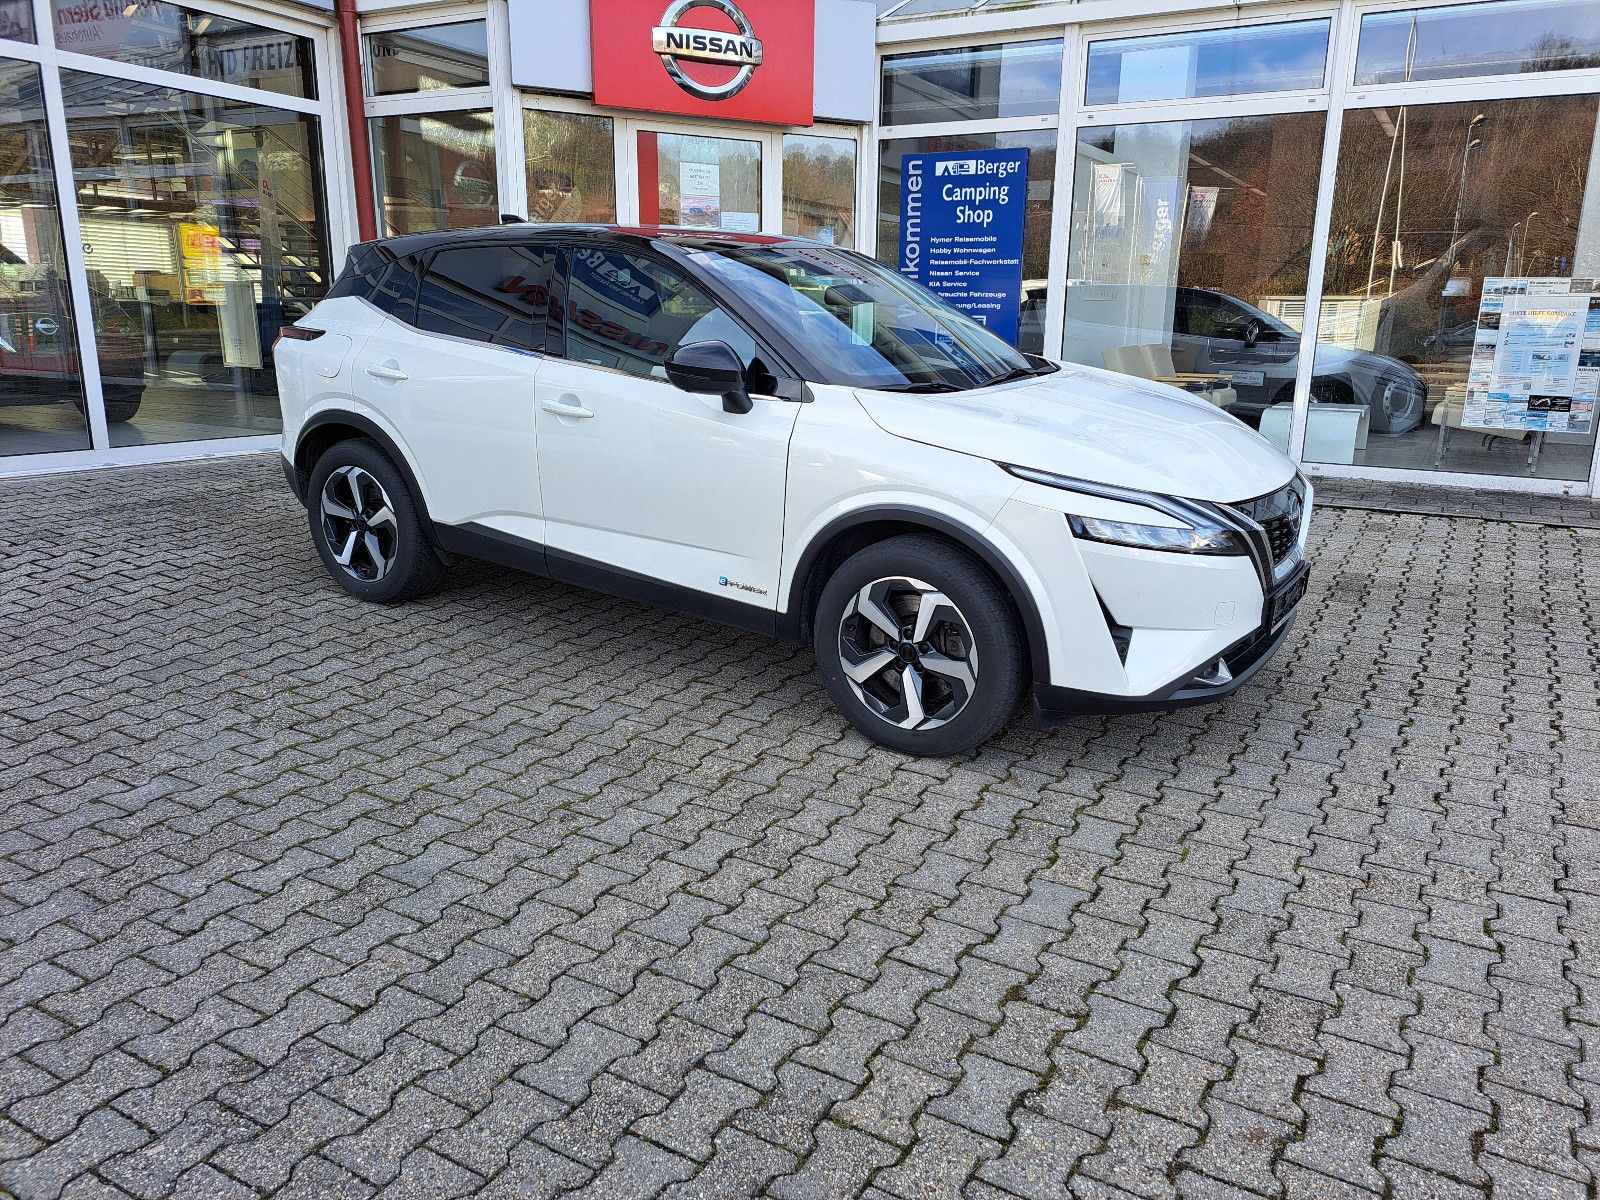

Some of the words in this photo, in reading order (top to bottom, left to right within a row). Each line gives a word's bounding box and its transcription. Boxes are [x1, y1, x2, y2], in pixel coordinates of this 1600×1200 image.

[665, 32, 754, 59] NISSAN
[977, 159, 1021, 178] Berger
[942, 181, 1009, 205] Camping
[955, 205, 993, 228] Shop
[930, 236, 953, 244] Hymer
[930, 247, 952, 255] Hobby
[969, 291, 1007, 299] Fahrzeuge
